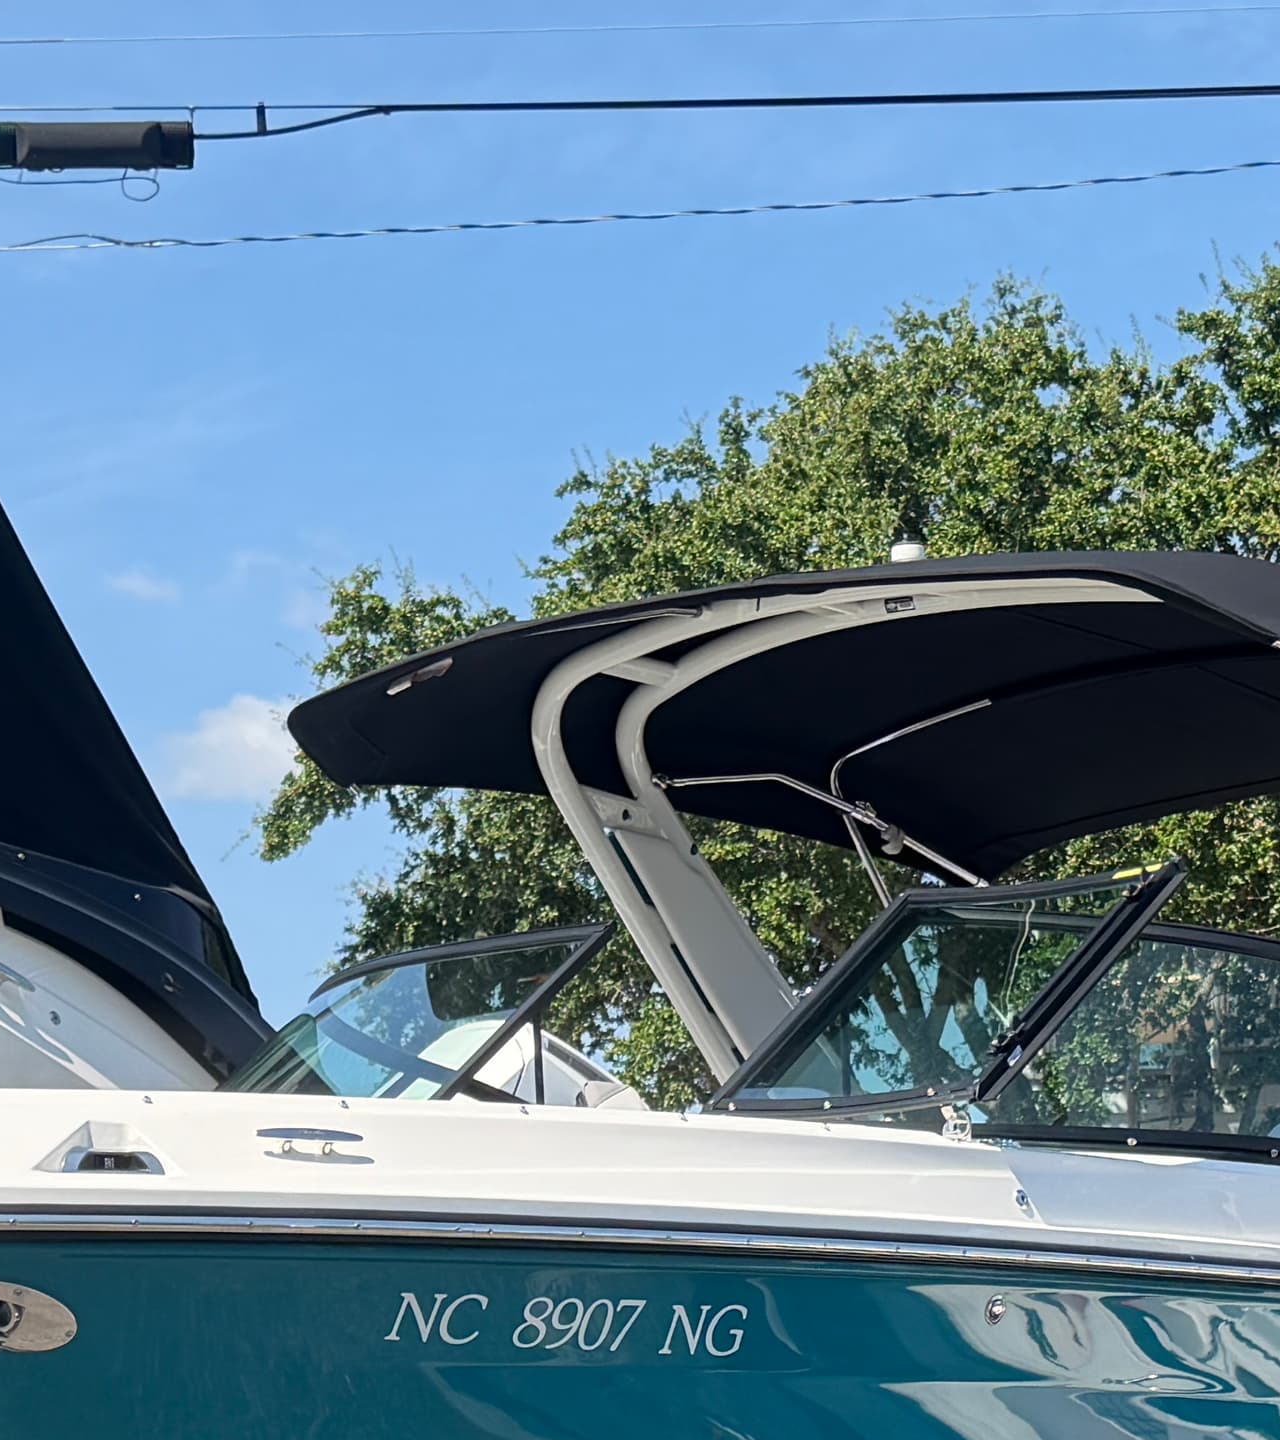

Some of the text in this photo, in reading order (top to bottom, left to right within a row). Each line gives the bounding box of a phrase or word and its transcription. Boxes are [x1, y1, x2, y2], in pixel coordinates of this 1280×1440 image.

[384, 1292, 748, 1356] NC 8907 NG
